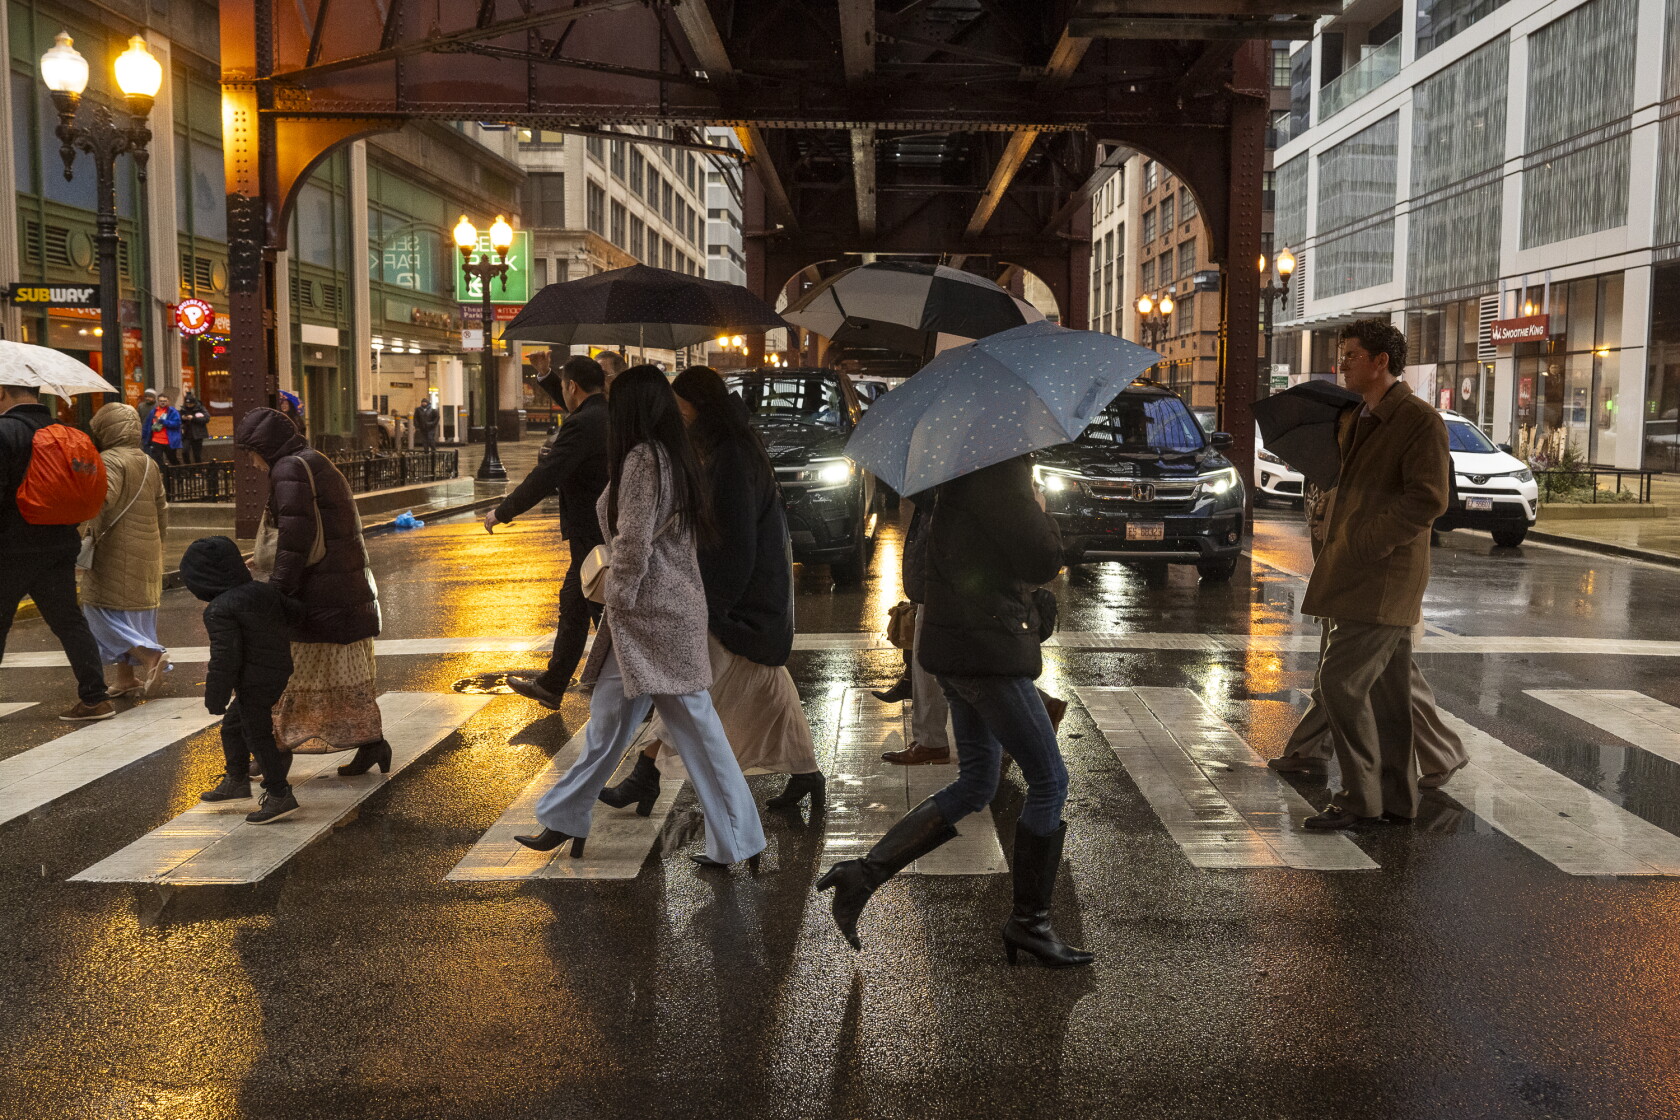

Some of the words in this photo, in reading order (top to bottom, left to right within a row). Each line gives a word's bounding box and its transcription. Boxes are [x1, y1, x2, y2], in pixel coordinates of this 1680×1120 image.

[14, 287, 94, 303] SUBWAY
[176, 299, 210, 315] LOUISIANA
[183, 306, 203, 326] P
[178, 321, 210, 335] KITCHEN
[1502, 328, 1530, 339] SMOOTHIE
